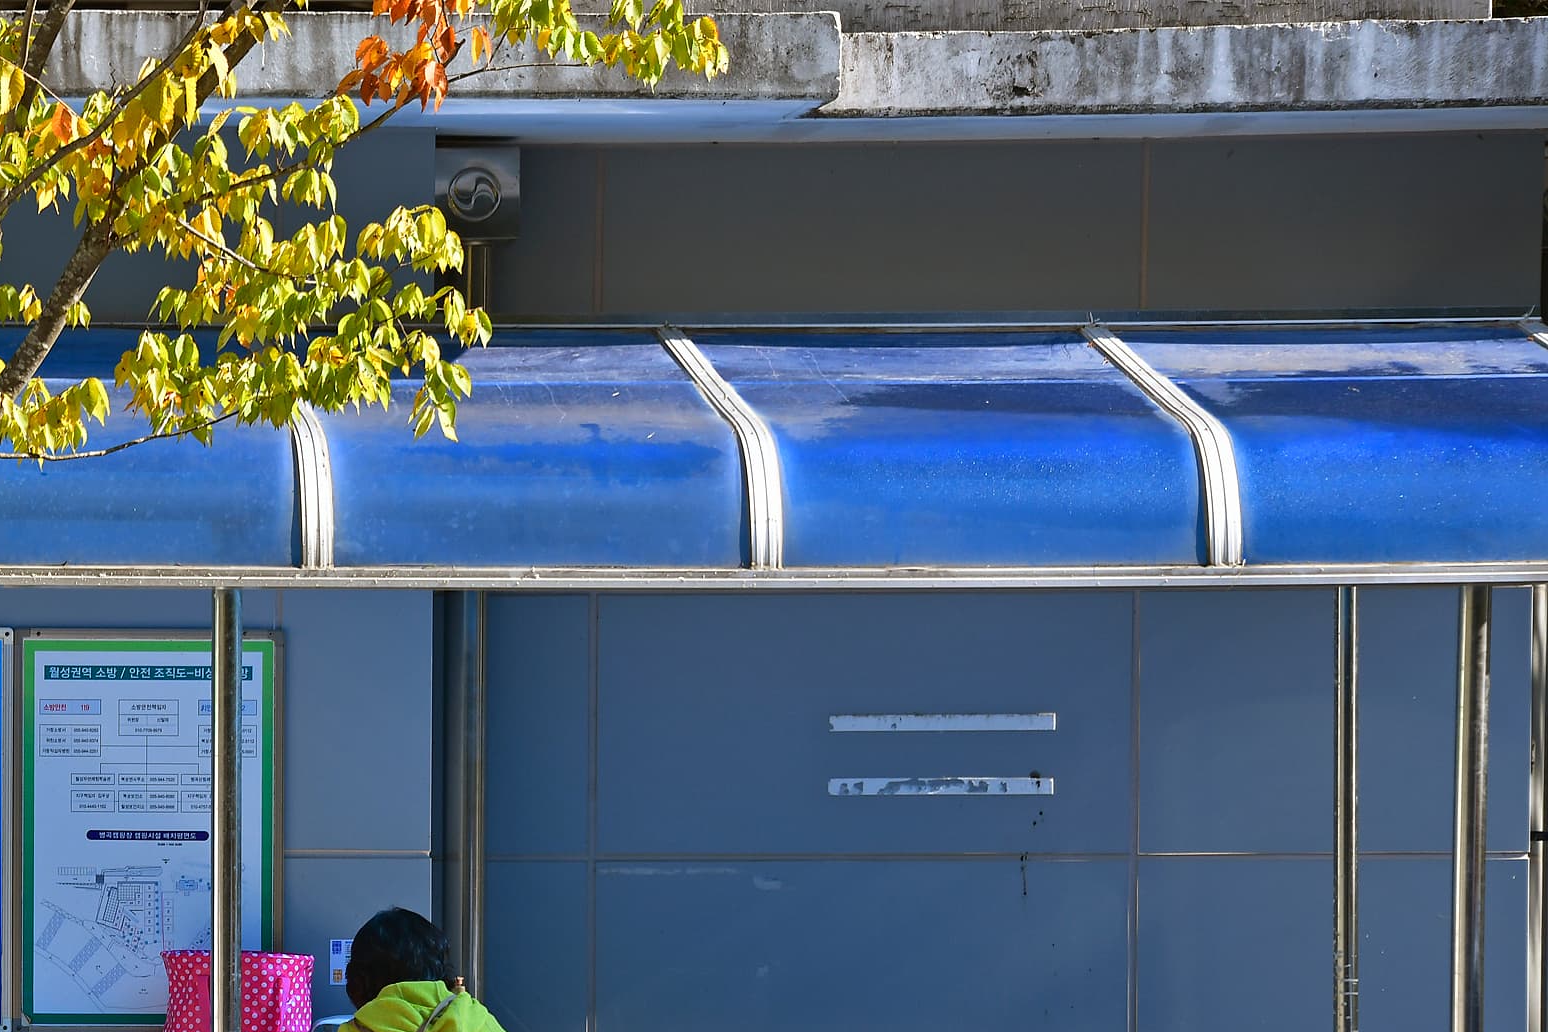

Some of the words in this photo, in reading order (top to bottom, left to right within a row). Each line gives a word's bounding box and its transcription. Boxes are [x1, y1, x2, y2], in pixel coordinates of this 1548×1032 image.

[50, 667, 93, 680] 월성권역
[96, 667, 118, 680] 소방
[129, 667, 151, 680] 안전
